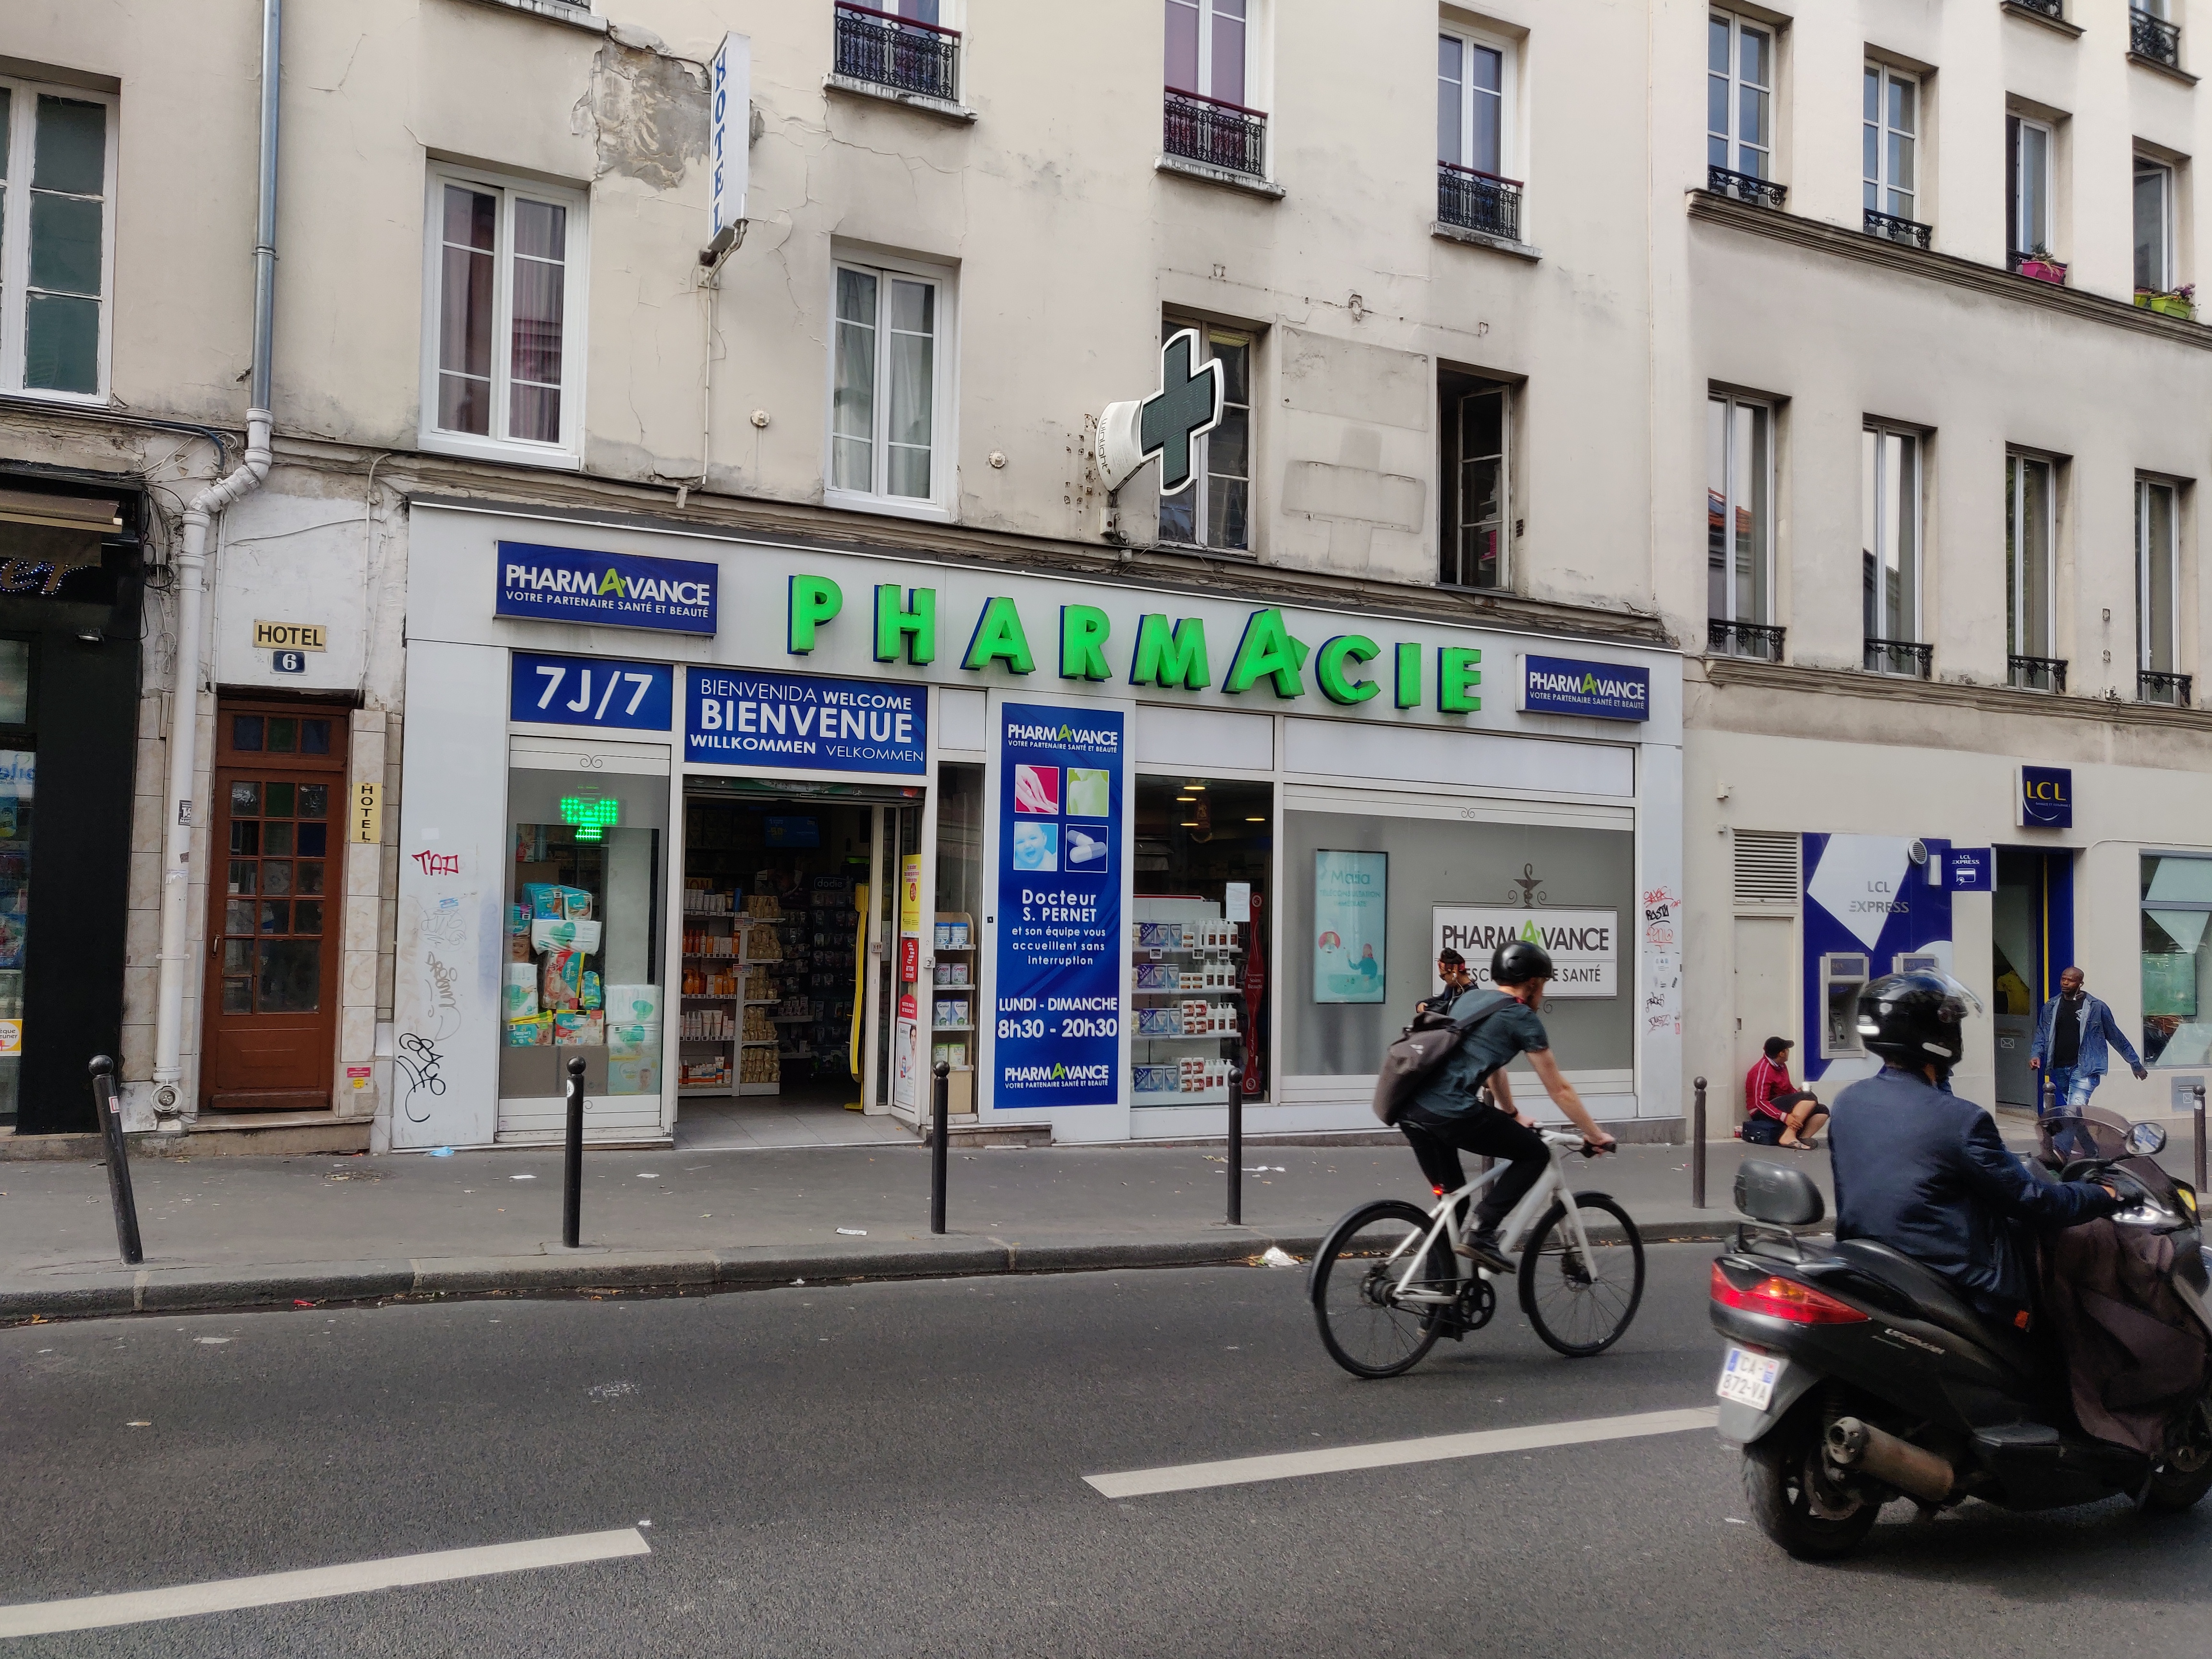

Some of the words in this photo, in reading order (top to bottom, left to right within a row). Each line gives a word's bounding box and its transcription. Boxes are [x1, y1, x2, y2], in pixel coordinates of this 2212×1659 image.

[713, 47, 727, 236] HOTEL
[506, 564, 709, 606] PHARMAVANCE
[505, 590, 543, 603] VOTRE
[546, 596, 614, 609] PARTENAIRE
[617, 601, 652, 613] SANTÉ
[655, 605, 666, 614] ET
[670, 606, 709, 618] BEAUTÉ
[258, 625, 323, 646] HOTEL
[787, 574, 1482, 714] PHARMACIE
[282, 653, 297, 670] 6
[536, 666, 653, 720] 7J/7
[701, 678, 817, 703] BIENVENIDA
[822, 691, 912, 710] WELCOME
[1529, 672, 1645, 700] PHARMAVANCE
[1529, 691, 1551, 700] VOTRE
[1552, 694, 1591, 704] PARTENAIRE
[1592, 697, 1612, 706] SANTÉ
[1622, 700, 1644, 709] BEAUTÉ
[701, 698, 912, 743] BIENVENUE
[1008, 724, 1118, 745] PHARMAVANCE
[690, 734, 816, 754] WILLKOMMEN
[825, 745, 924, 762] VELKOMMEN
[1030, 741, 1066, 749] PARTENAIRE
[2026, 781, 2067, 801] LCL
[360, 785, 374, 841] HOTEL
[817, 878, 842, 888] dodie
[1867, 881, 1890, 893] LCL
[1022, 889, 1096, 905] Docteur
[1849, 901, 1910, 913] EXPRESS
[1022, 907, 1035, 921] S.
[1042, 907, 1097, 922] PERNET
[1011, 926, 1022, 936] et
[1046, 926, 1080, 938] équipe
[1442, 919, 1609, 951] PHARMAVANCE
[1012, 941, 1077, 950] accueillent
[1028, 955, 1093, 967] interruption
[1562, 964, 1601, 982] SANTÉ
[999, 998, 1036, 1011] LUNDI
[1047, 998, 1118, 1011] DIMANCHE
[998, 1019, 1044, 1039] 8h30
[1061, 1018, 1118, 1037] 20h30
[1005, 1062, 1108, 1081] PHARMAVANCE
